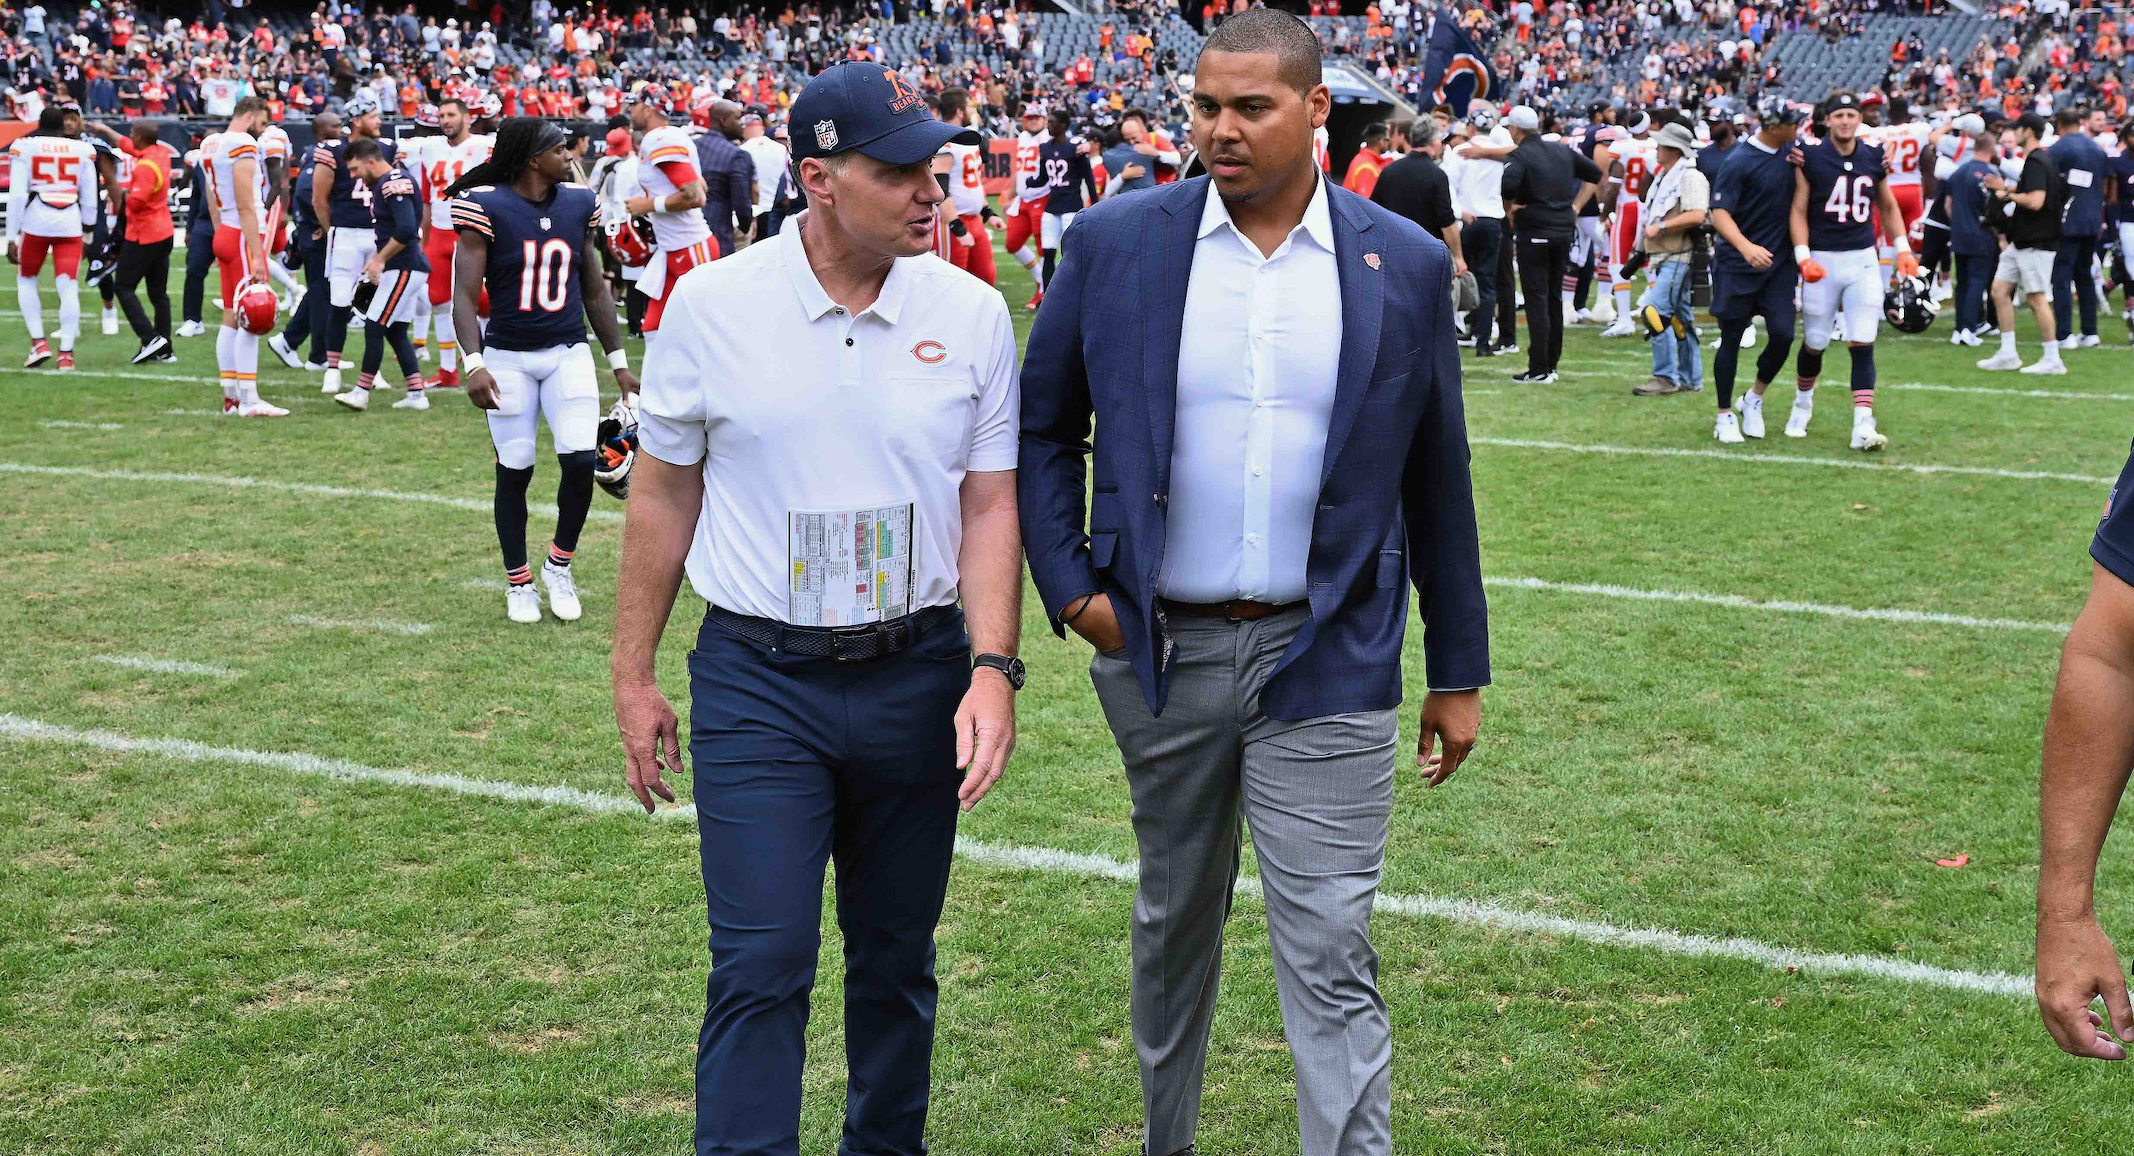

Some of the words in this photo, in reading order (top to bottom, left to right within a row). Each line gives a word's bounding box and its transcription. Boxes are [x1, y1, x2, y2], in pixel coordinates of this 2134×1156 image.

[819, 131, 836, 147] NFL
[32, 156, 79, 185] 55
[431, 161, 463, 199] 41
[982, 153, 1011, 178] AR
[1625, 157, 1646, 196] 8
[203, 159, 223, 208] 7
[351, 178, 374, 207] 4
[1824, 174, 1873, 223] 46
[518, 237, 573, 312] 10
[910, 340, 947, 364] C
